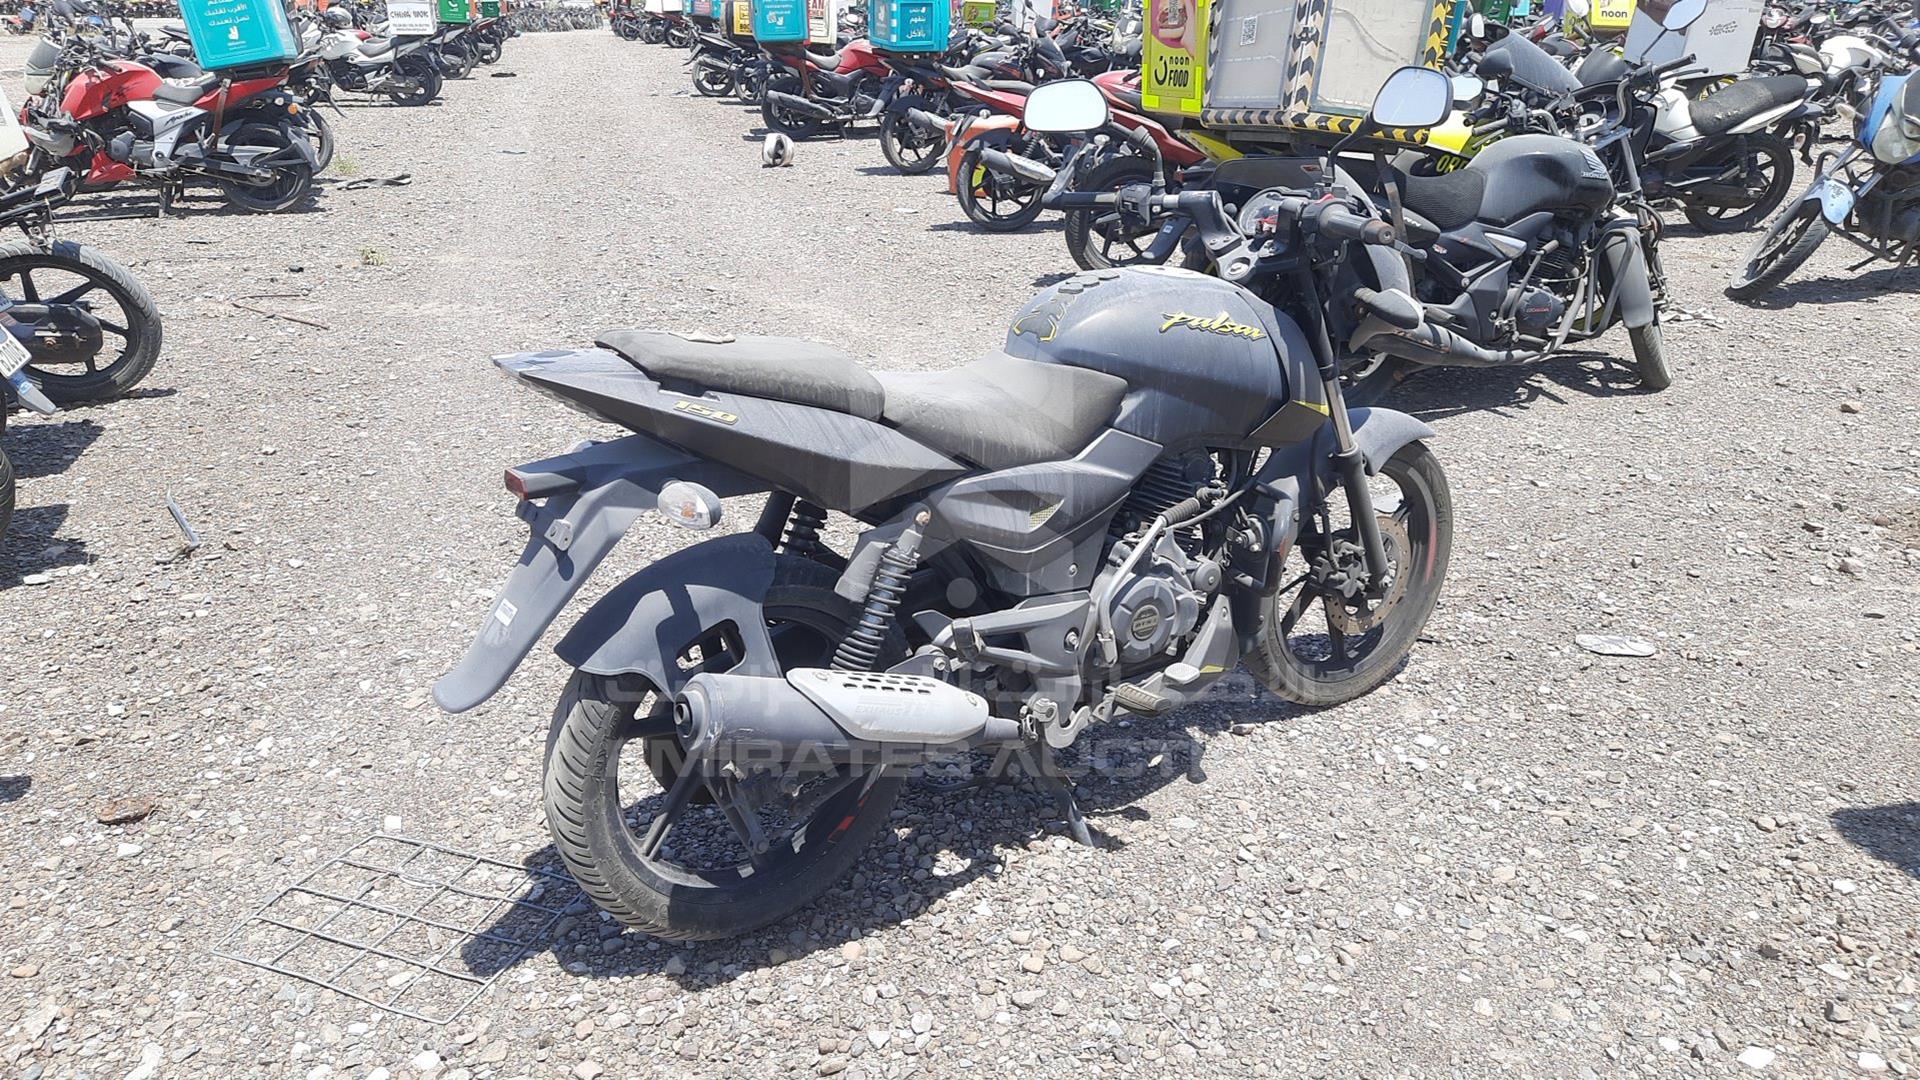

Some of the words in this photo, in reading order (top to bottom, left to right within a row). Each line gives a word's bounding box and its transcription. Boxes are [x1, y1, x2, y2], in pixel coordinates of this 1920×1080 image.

[1601, 10, 1628, 18] noon
[1169, 56, 1189, 65] noon
[1168, 69, 1189, 87] FOOD
[1580, 170, 1609, 179] HONDA
[1159, 310, 1267, 341] Pulsar
[674, 400, 739, 424] 150
